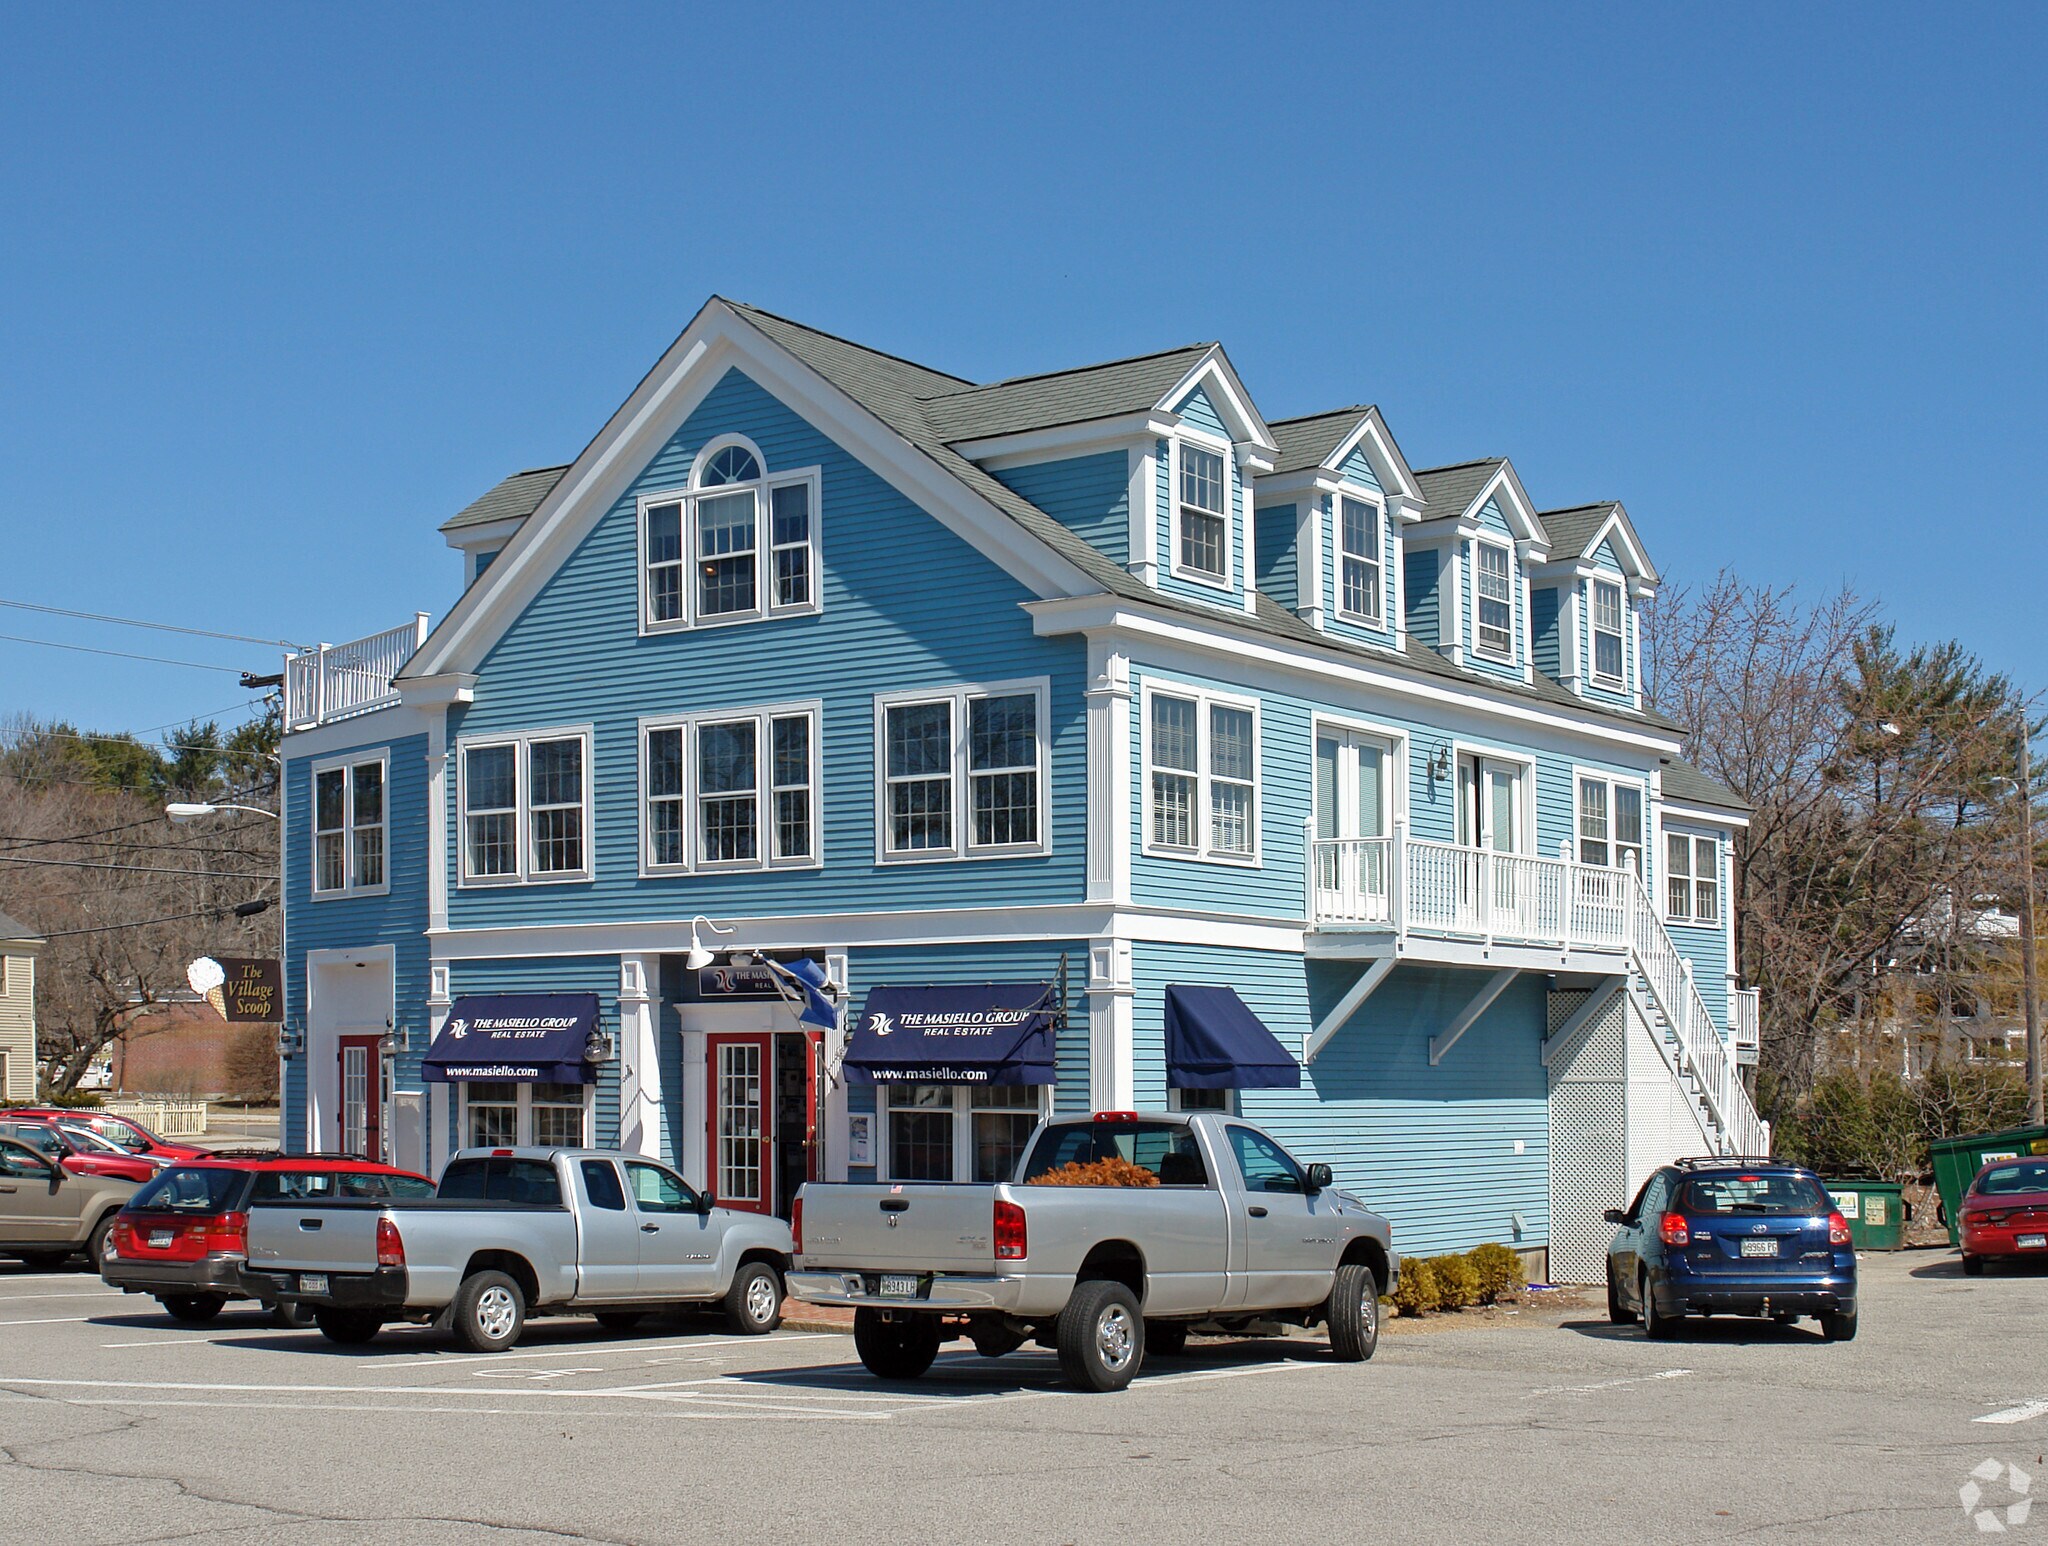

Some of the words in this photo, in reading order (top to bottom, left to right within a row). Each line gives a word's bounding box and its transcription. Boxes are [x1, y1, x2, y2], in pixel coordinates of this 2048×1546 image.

[242, 964, 262, 978] The
[736, 971, 751, 979] THE
[228, 979, 274, 1000] Village
[237, 999, 271, 1017] Scoop
[473, 1019, 493, 1028] THE
[493, 1018, 539, 1028] MASIELLO
[541, 1017, 578, 1027] GROUP
[900, 1013, 923, 1024] THE
[924, 1012, 984, 1024] MASIELLO
[986, 1011, 1030, 1022] GROUP
[491, 1031, 512, 1039] REAL
[924, 1028, 949, 1036] REAL
[954, 1027, 994, 1036] ESTATE
[446, 1065, 538, 1077] www.masiello.com
[872, 1067, 987, 1080] www.masiello.com
[887, 1280, 905, 1292] 8943
